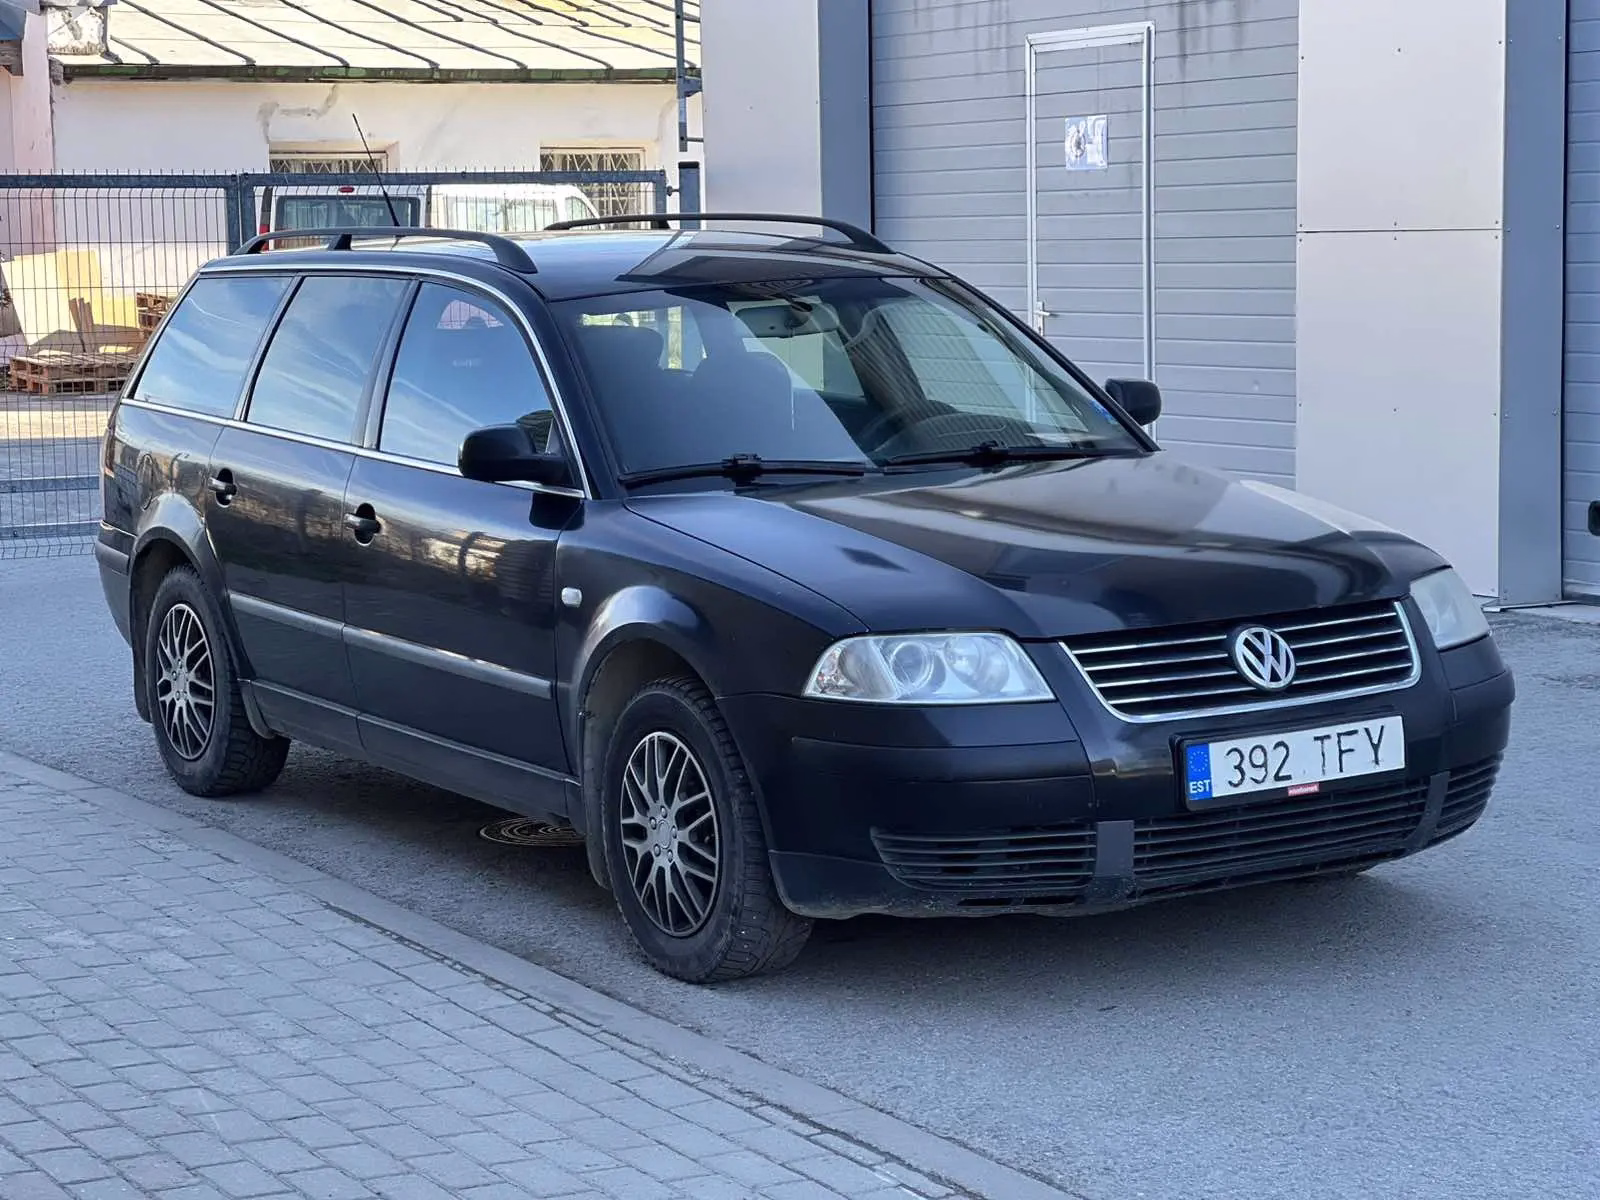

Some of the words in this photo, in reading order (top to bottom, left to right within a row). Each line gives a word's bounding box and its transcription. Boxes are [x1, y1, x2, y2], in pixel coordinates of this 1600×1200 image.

[1225, 741, 1292, 788] 392
[1313, 725, 1384, 776] TFY
[1189, 780, 1211, 794] EST
